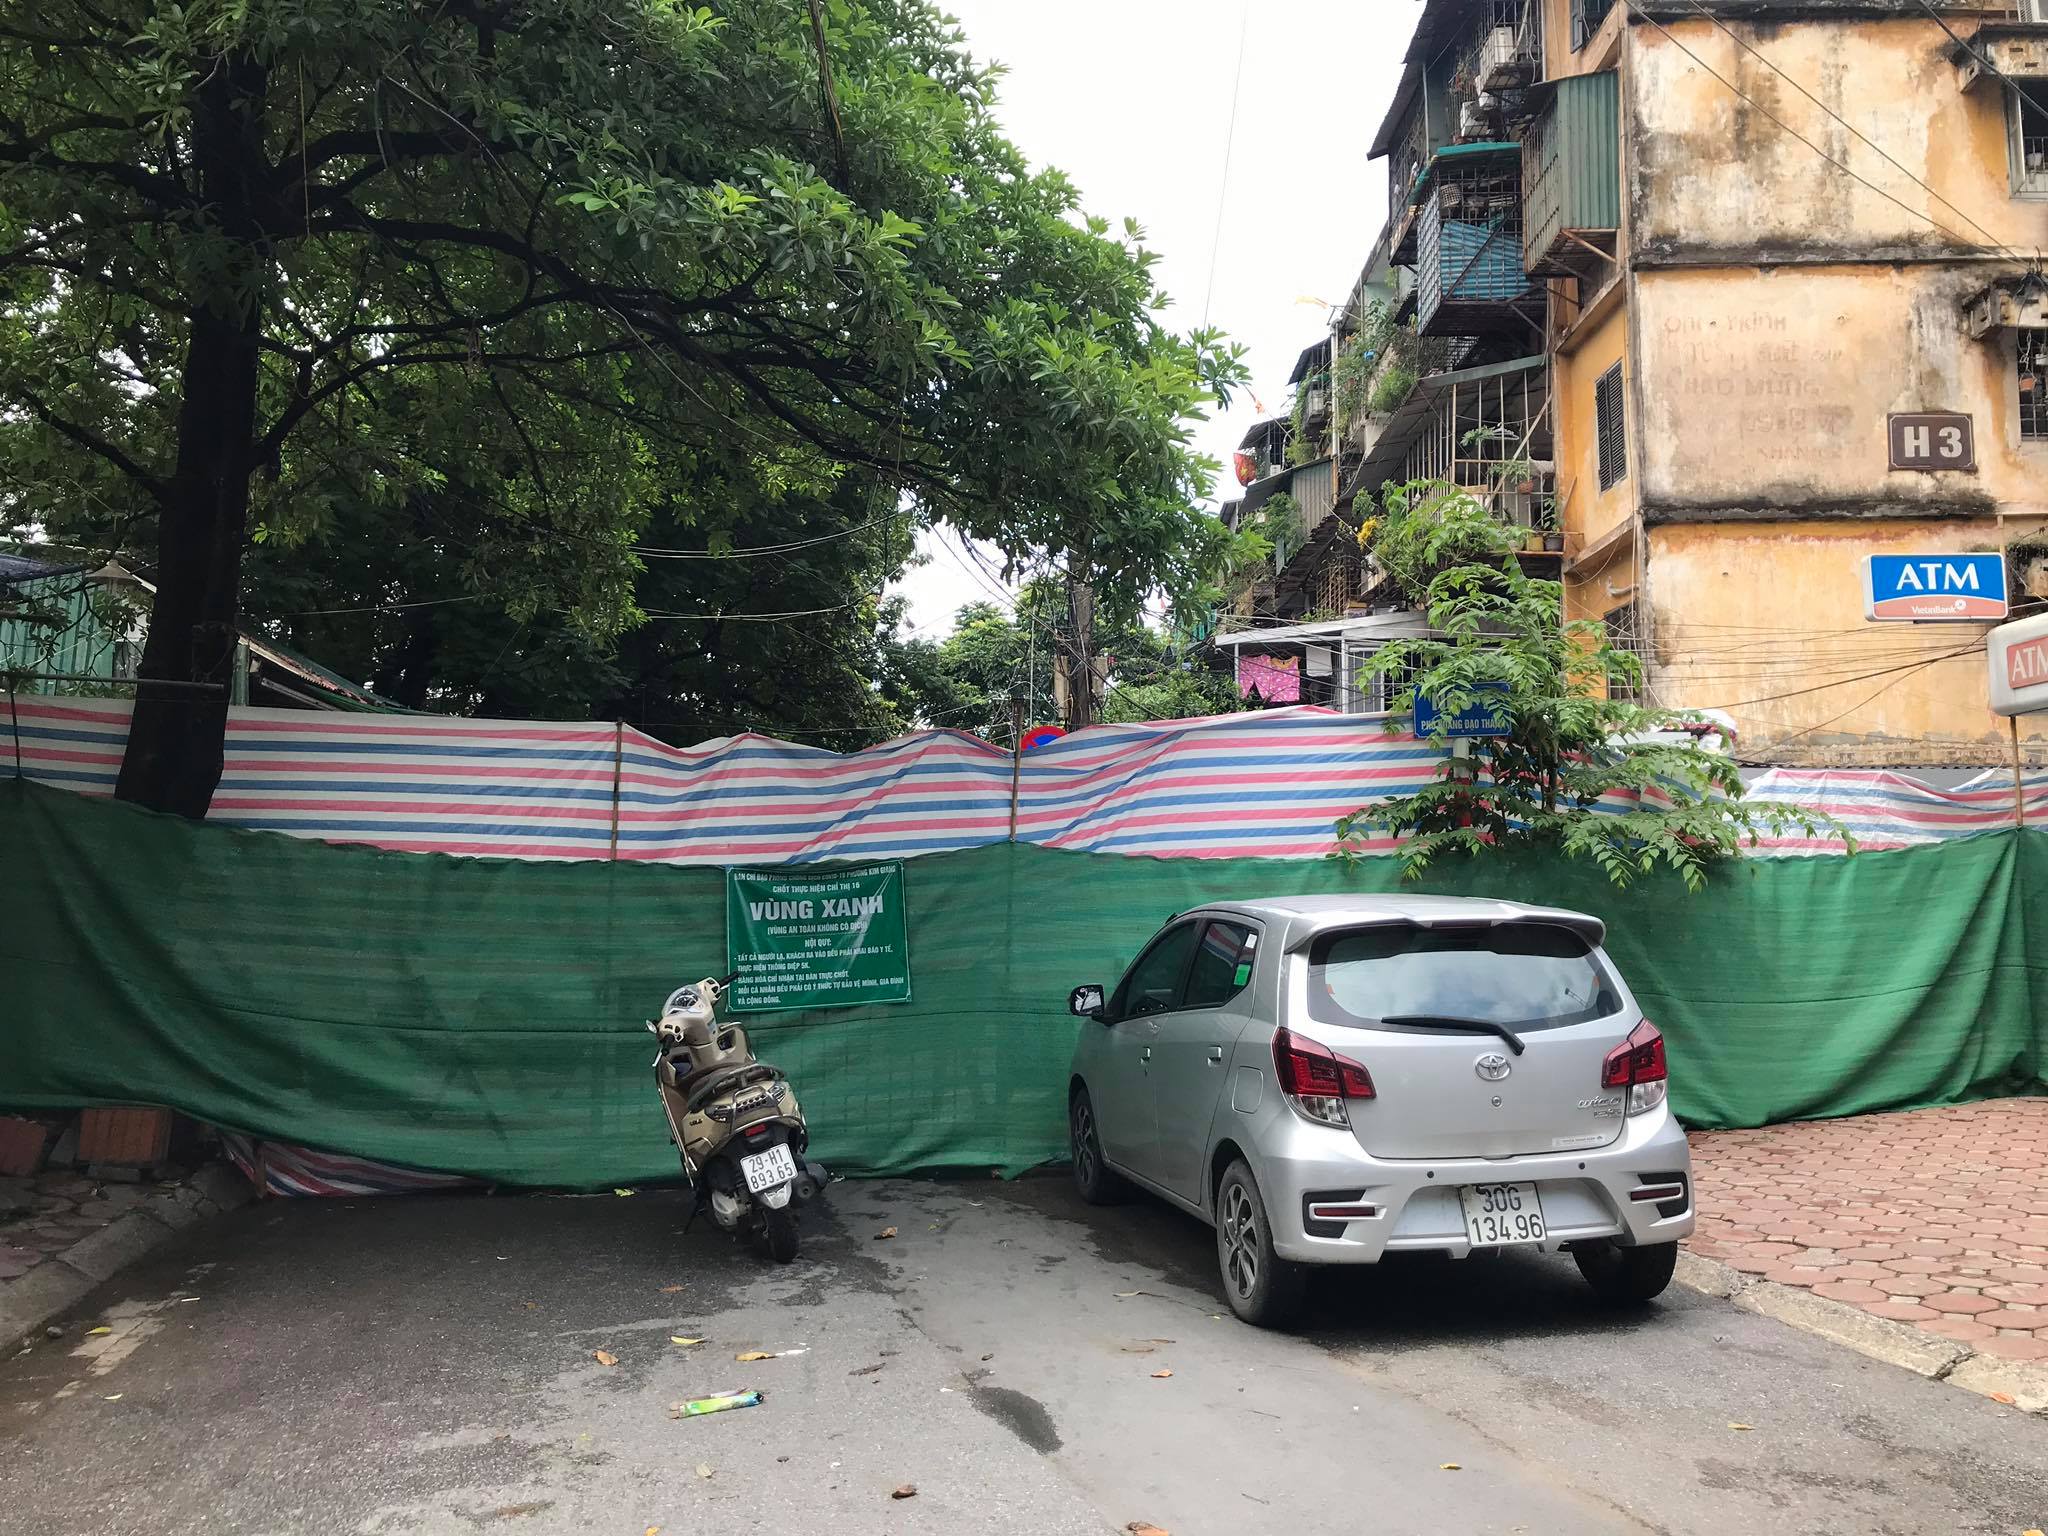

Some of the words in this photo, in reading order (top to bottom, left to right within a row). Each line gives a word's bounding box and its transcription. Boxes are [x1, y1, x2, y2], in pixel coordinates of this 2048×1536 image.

[1904, 426, 1930, 458] H
[1939, 426, 1963, 458] 3
[1896, 563, 1980, 591] ATM
[1464, 719, 1479, 731] ĐẠO
[869, 867, 880, 876] KIM
[773, 883, 790, 893] CHỐT
[791, 885, 809, 894] THỰC
[810, 884, 826, 893] HIỆN
[827, 881, 839, 891] CHỈ
[840, 882, 850, 891] THỊ
[749, 897, 814, 920] VÙNG
[821, 894, 884, 918] XANH
[788, 925, 798, 934] AN
[800, 923, 816, 933] TOÀN
[817, 922, 839, 932] KHÔNG
[840, 920, 849, 930] CÓ
[804, 937, 816, 949] NỘI
[737, 952, 748, 962] TẤT
[749, 952, 757, 961] CẢ
[786, 951, 805, 960] KHÁCH
[806, 951, 814, 959] RA
[815, 949, 826, 958] VÀO
[839, 947, 853, 956] PHẢI
[867, 945, 879, 954] BÁO
[737, 964, 752, 973] THỰC
[753, 963, 767, 972] HIỆN
[767, 961, 786, 971] THÔNG
[787, 962, 801, 971] ĐIỆP
[759, 985, 776, 993] NHÂN
[789, 983, 802, 992] PHẢI
[803, 982, 812, 991] CÓ
[812, 982, 817, 990] Ý
[817, 981, 832, 990] THỨC
[833, 980, 841, 990] TỰ
[853, 978, 861, 988] VỆ
[879, 977, 889, 985] GIA
[778, 974, 794, 983] NHẬN
[795, 973, 804, 983] TẠI
[818, 971, 833, 980] TRỰC
[737, 997, 746, 1005] VÀ
[746, 996, 762, 1006] CỘNG
[749, 1149, 783, 1173] 29-H1
[750, 1162, 793, 1189] 893.65
[1476, 1186, 1522, 1213] 30G
[1471, 1213, 1543, 1242] 134.96
